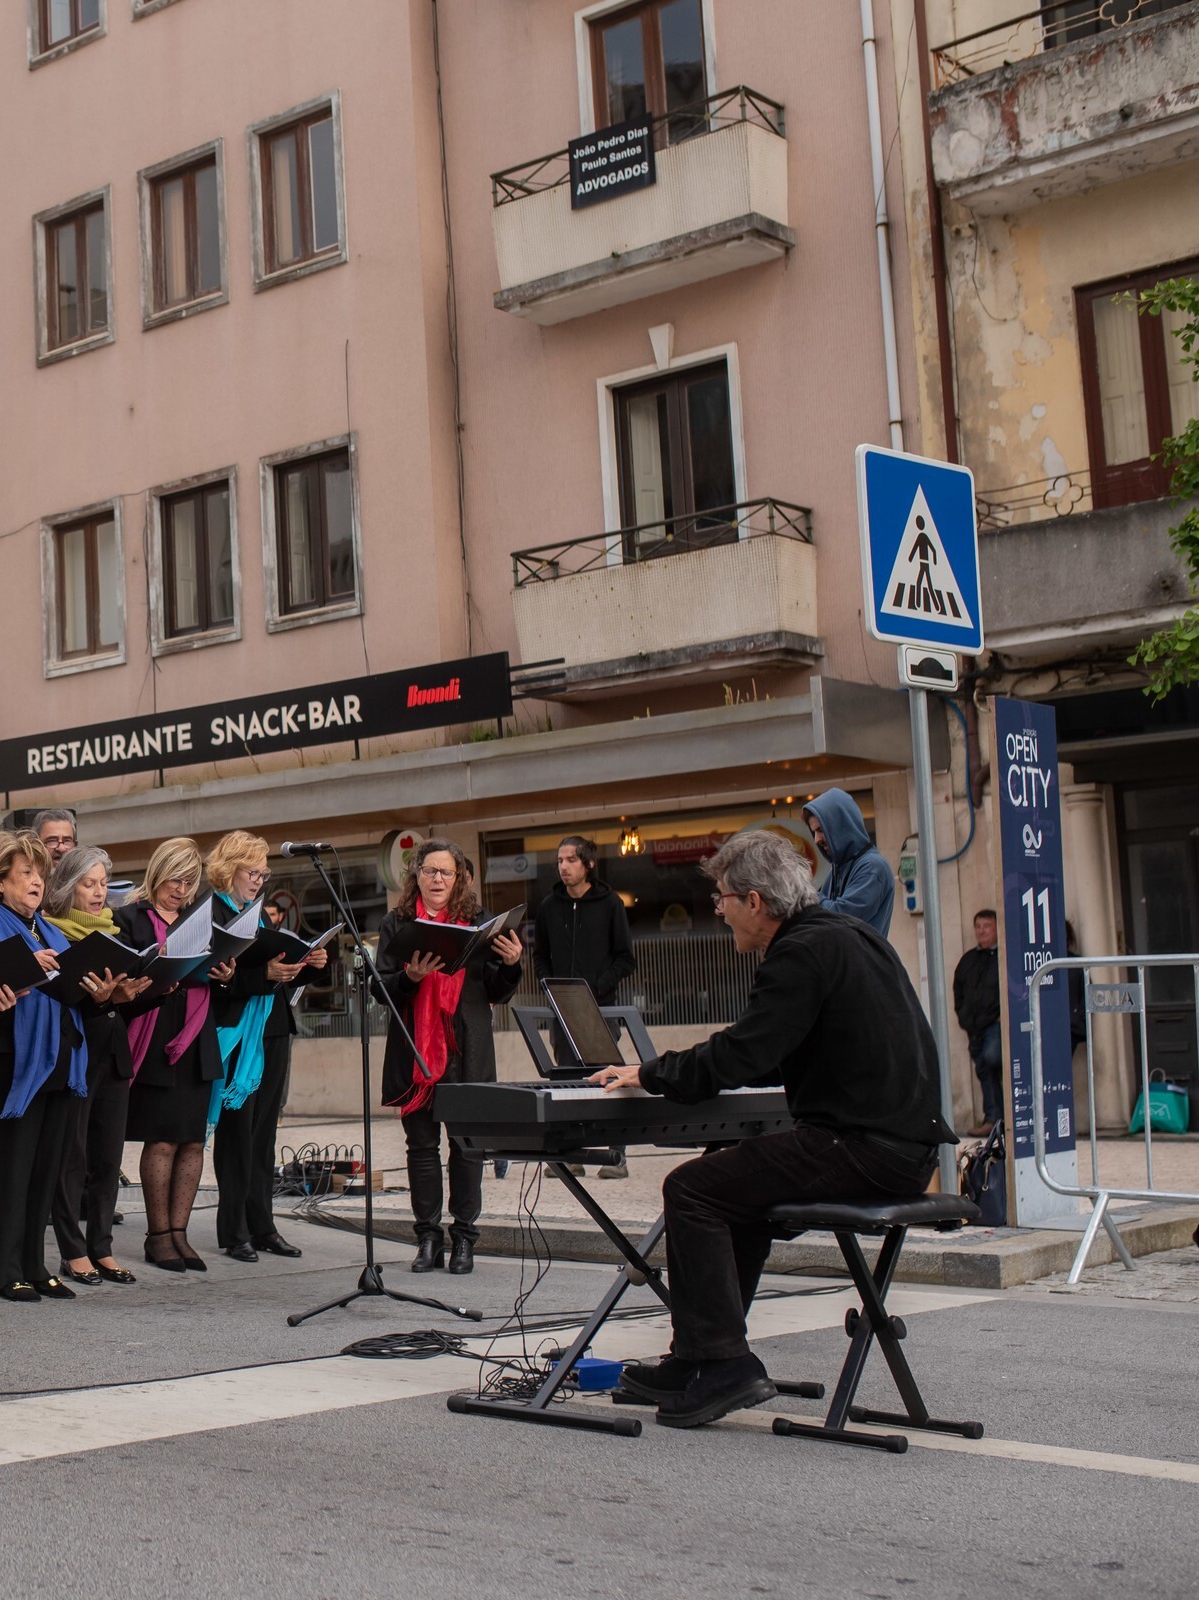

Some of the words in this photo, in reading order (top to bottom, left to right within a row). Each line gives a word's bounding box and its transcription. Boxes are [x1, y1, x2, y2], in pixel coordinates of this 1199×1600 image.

[573, 144, 596, 159] João
[597, 134, 626, 151] Pedro
[627, 126, 649, 141] Dias
[581, 156, 608, 172] Paulo
[609, 145, 642, 163] Santos
[576, 161, 649, 195] ADVOGADOS
[407, 677, 461, 708] Buondi
[27, 722, 193, 775] RESTAURANTE
[210, 694, 362, 746] SNACK-BAR
[1005, 732, 1038, 763] OPEN
[1007, 763, 1051, 809] CITY
[1021, 886, 1051, 944] 11
[1093, 989, 1135, 1007] CMA
